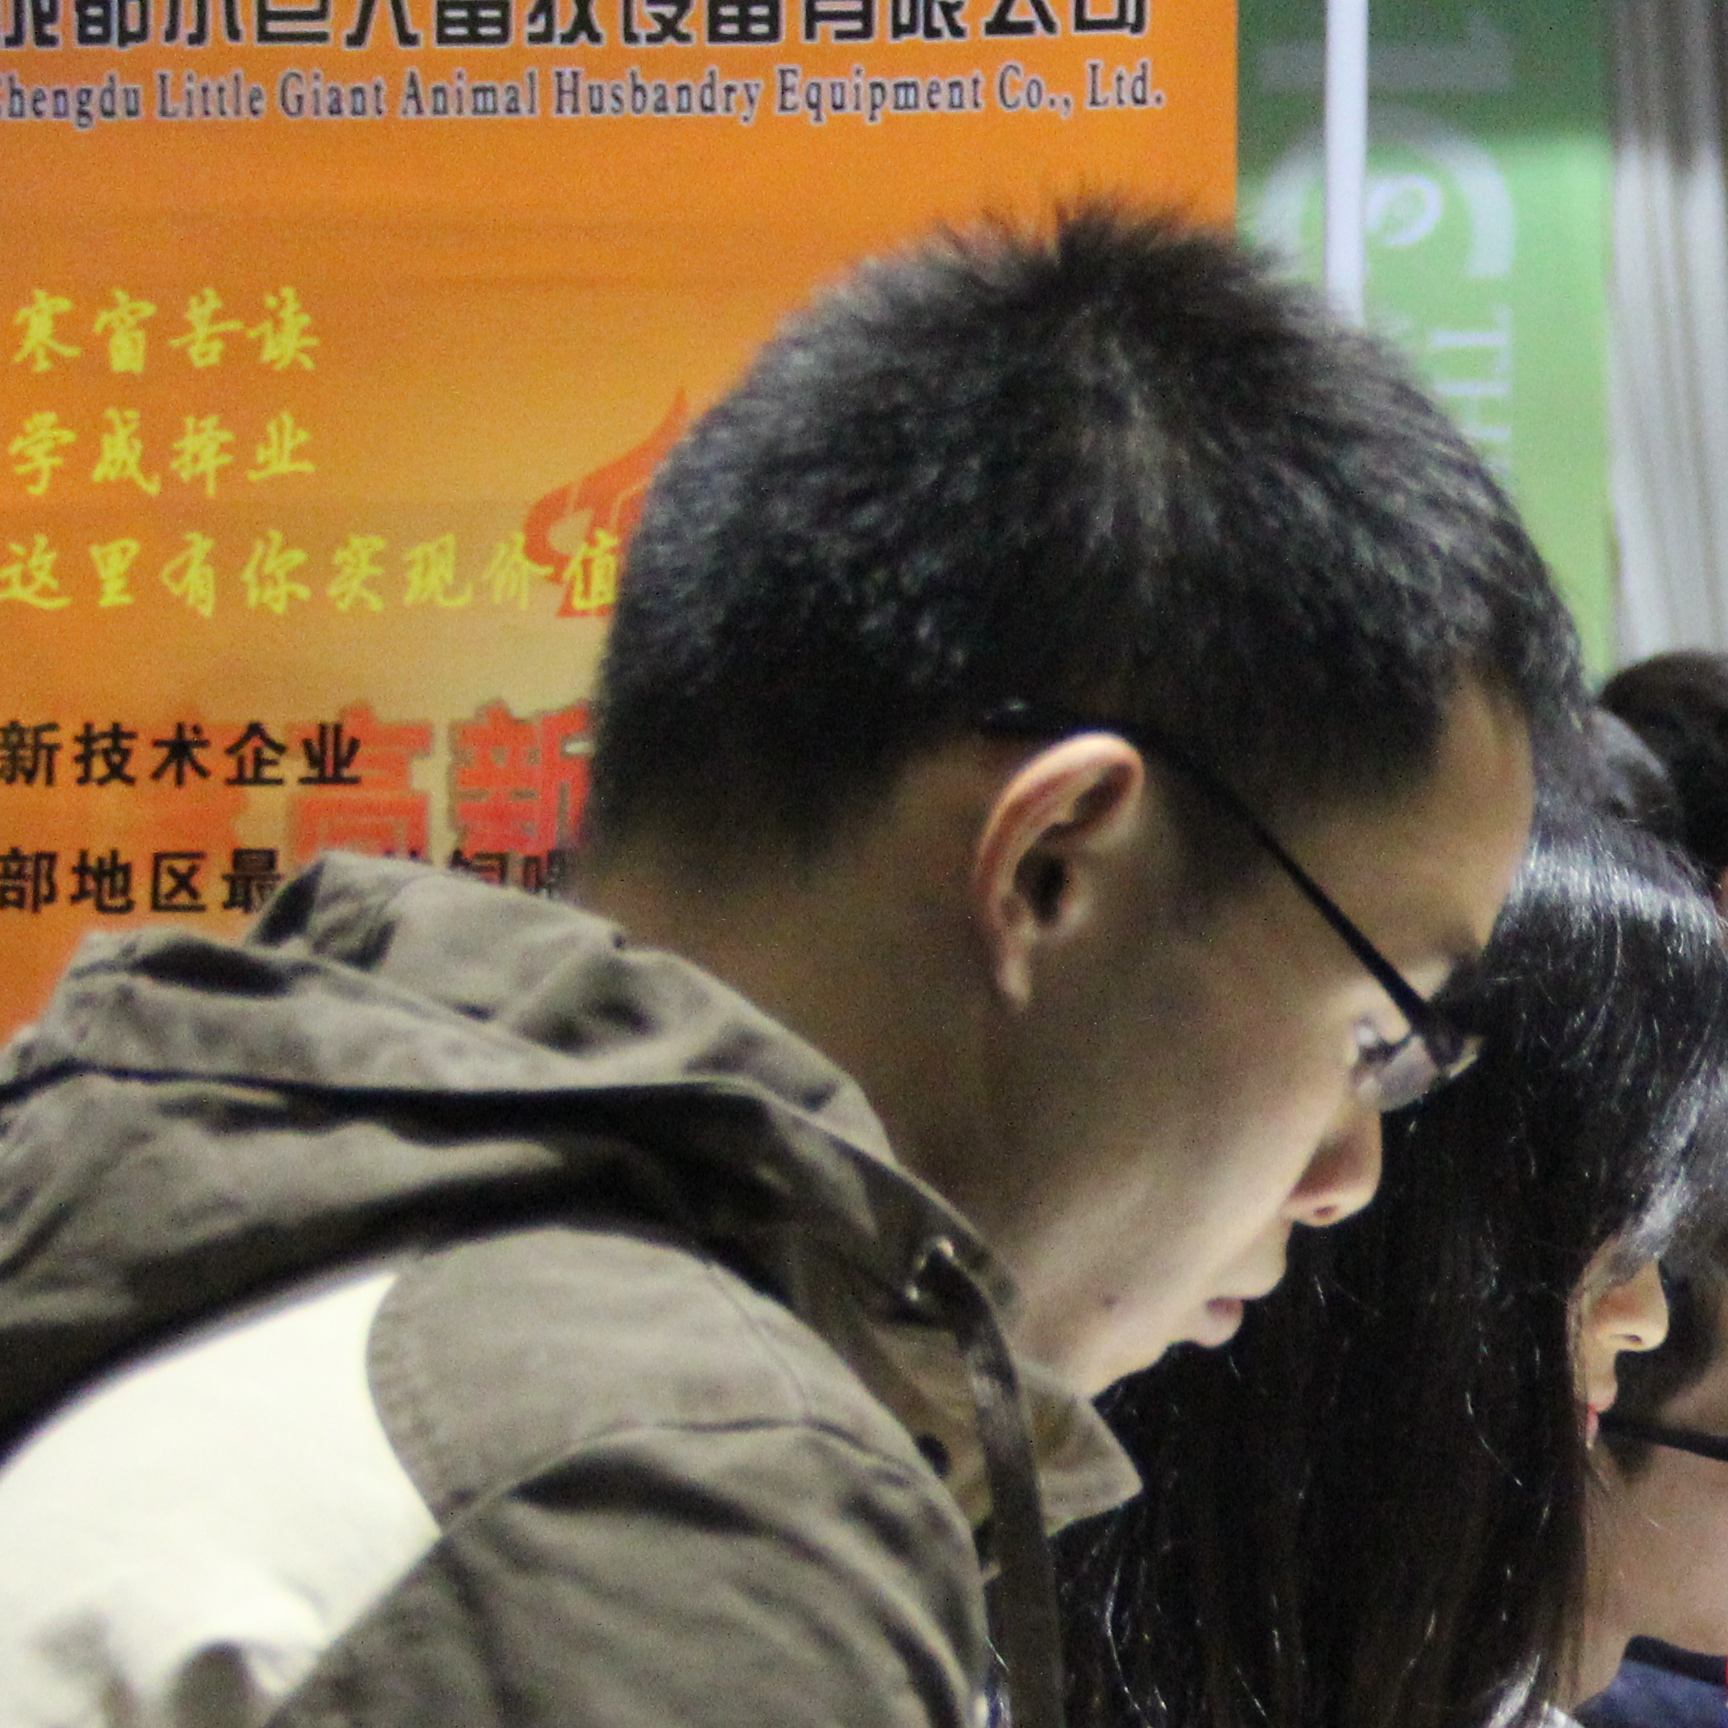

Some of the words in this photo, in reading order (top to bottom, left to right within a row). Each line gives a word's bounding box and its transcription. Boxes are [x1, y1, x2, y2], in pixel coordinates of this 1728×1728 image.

[0, 73, 142, 128] hengdu
[155, 71, 266, 119] Little
[278, 70, 387, 118] Giant
[400, 67, 540, 117] Animal
[552, 64, 762, 123] Husbandry
[775, 65, 983, 124] Equipment
[998, 62, 1074, 118] Co.,
[1087, 59, 1165, 109] Ltd.
[0, 719, 362, 787] 新技术企业
